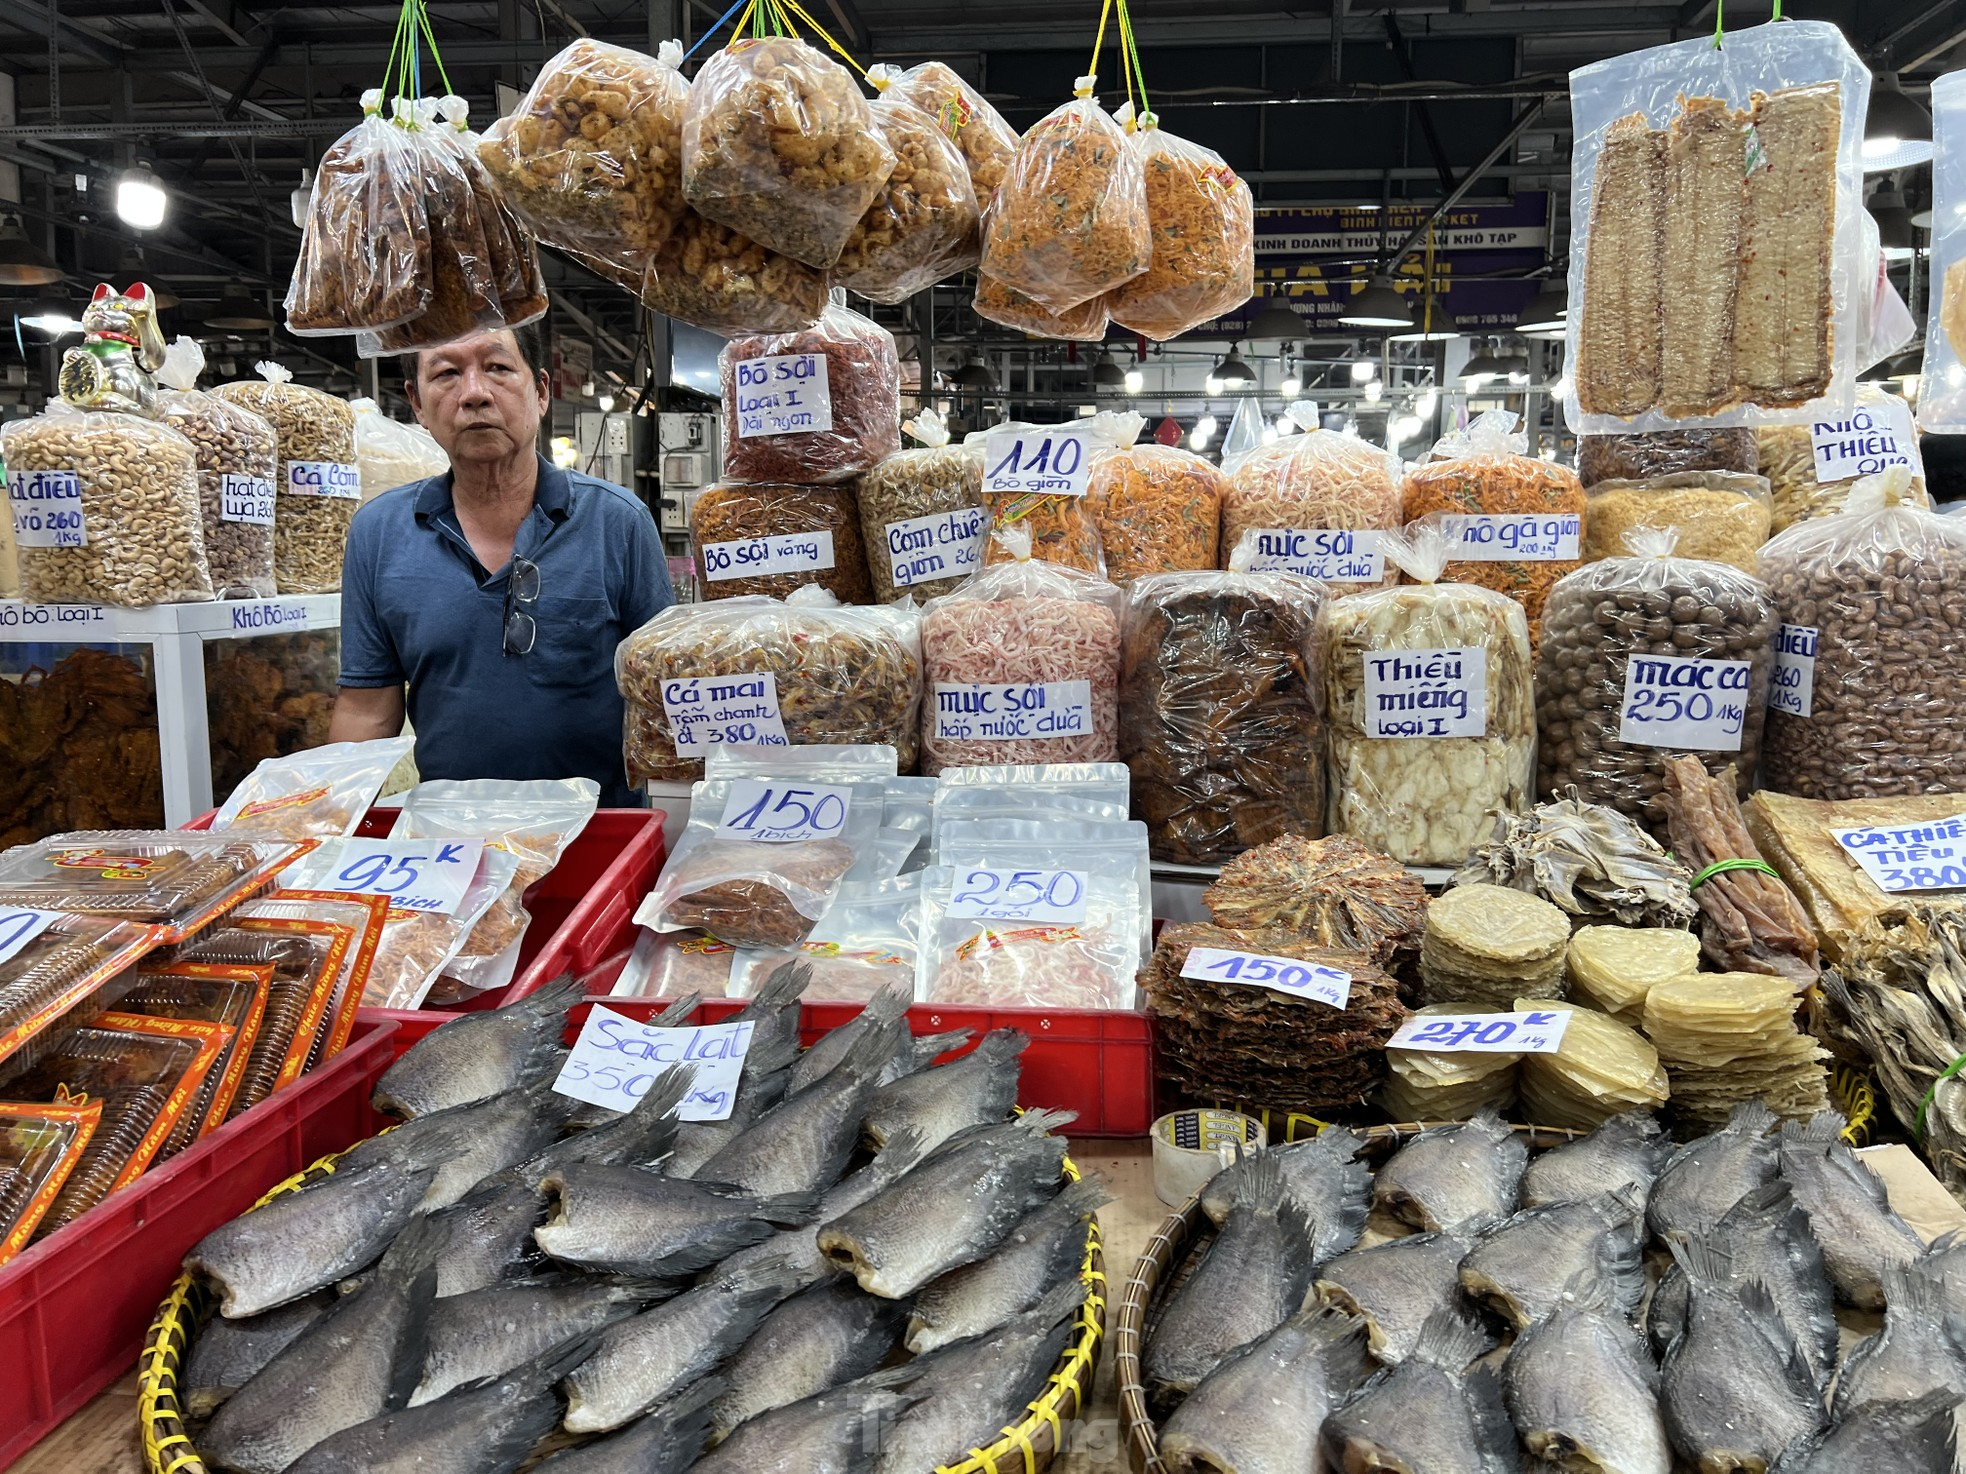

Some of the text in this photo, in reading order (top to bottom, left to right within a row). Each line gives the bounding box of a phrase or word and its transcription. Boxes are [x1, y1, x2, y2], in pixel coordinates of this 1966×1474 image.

[1291, 238, 1341, 249] DOANH
[1453, 231, 1484, 244] KHÔ
[1489, 232, 1517, 245] TẠP
[785, 390, 803, 406] I
[986, 438, 1082, 480] 110
[46, 511, 82, 530] 260
[92, 607, 104, 620] I
[232, 605, 263, 629] Khô
[1717, 667, 1751, 689] ca
[1773, 665, 1801, 687] 260
[665, 679, 700, 705] Cá
[714, 704, 778, 721] chanh
[1626, 690, 1713, 722] 250
[707, 723, 756, 744] 380
[940, 717, 973, 741] hấp
[1427, 718, 1450, 736] I
[726, 788, 845, 831] 150
[1880, 865, 1966, 890] 380
[953, 871, 1084, 908] 250
